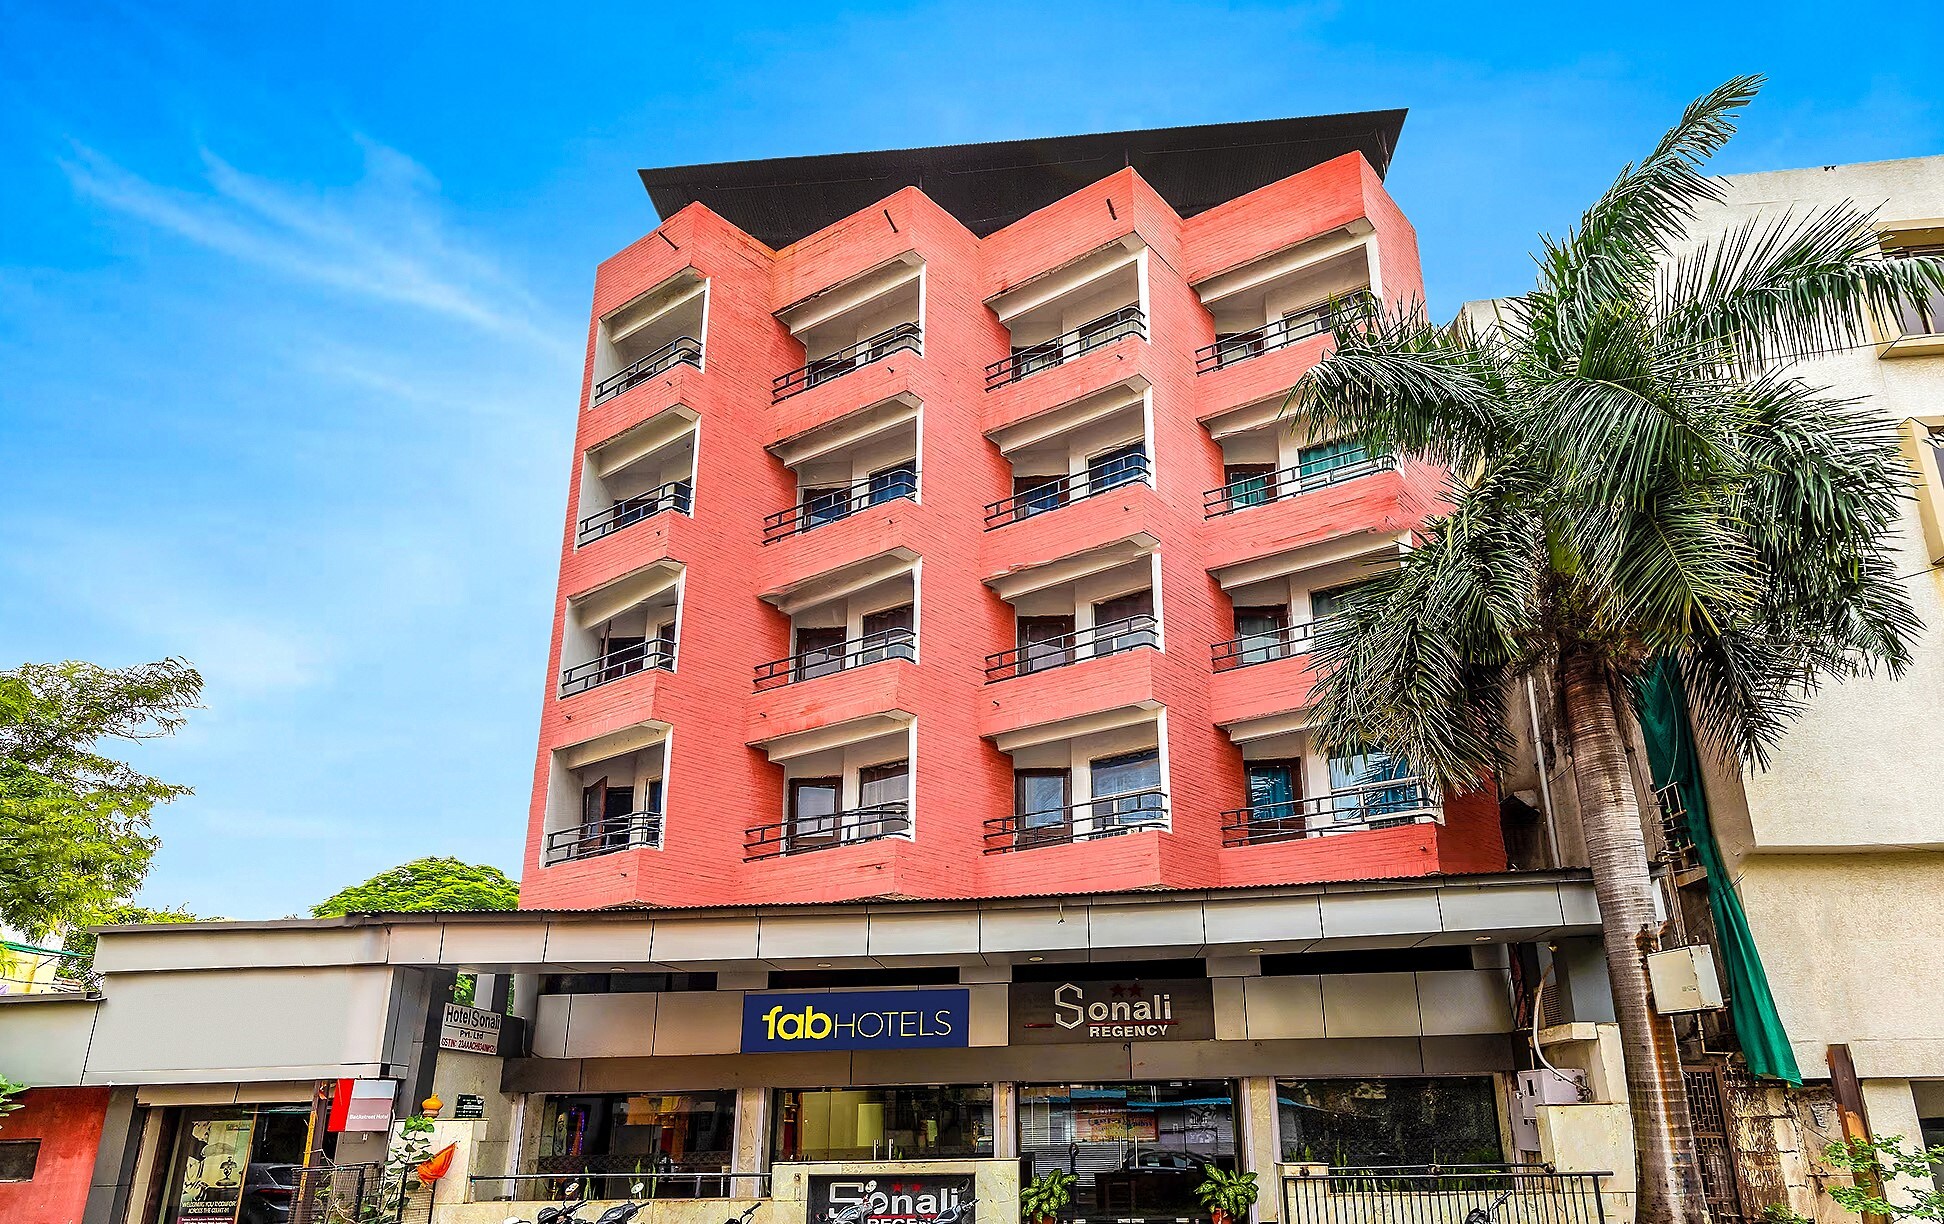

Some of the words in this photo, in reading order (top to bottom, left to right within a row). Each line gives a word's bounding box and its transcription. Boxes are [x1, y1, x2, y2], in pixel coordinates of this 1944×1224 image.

[446, 1005, 471, 1025] Hotel
[471, 1010, 500, 1030] Sonali
[1054, 982, 1172, 1030] Sonali
[1089, 1025, 1168, 1038] REGENCY
[829, 1181, 959, 1219] Sonali
